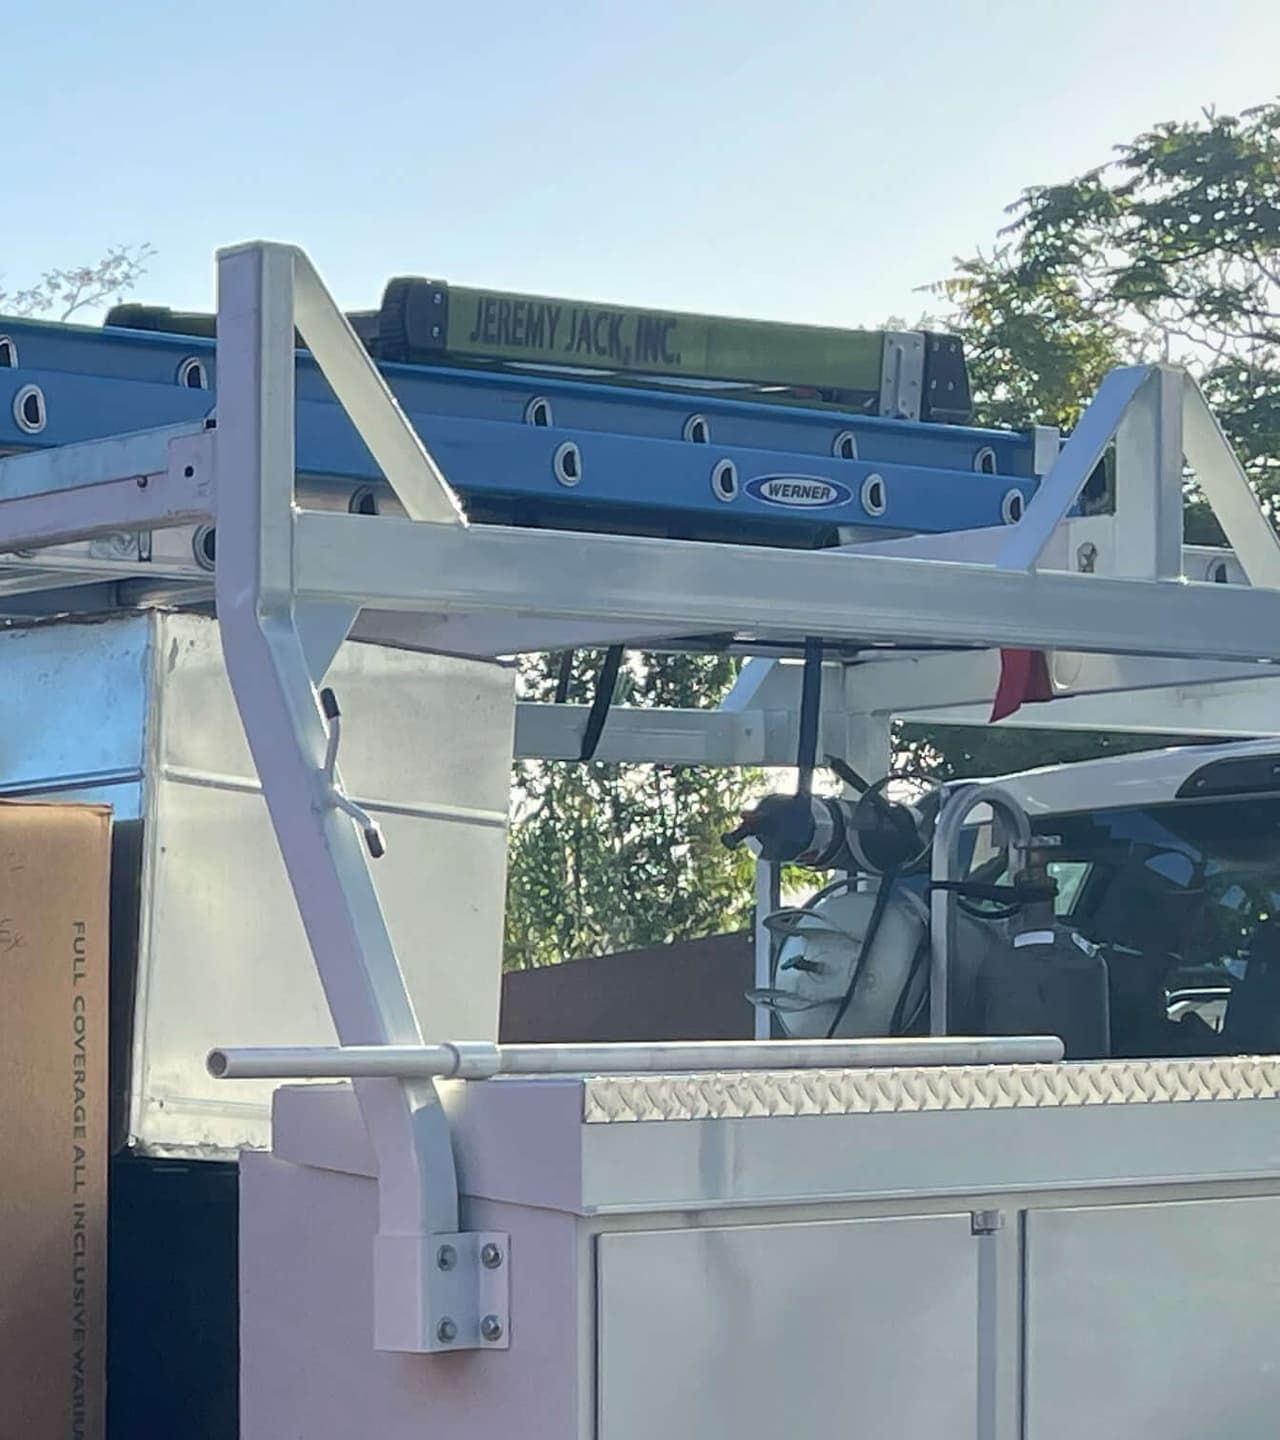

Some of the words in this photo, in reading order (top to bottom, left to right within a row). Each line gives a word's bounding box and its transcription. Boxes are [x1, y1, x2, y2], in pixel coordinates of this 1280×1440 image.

[470, 297, 561, 349] JEREMY
[565, 310, 631, 366] JACK,
[631, 316, 682, 366] INC.
[768, 482, 832, 502] WERNER
[72, 920, 86, 987] FULL
[72, 995, 87, 1140] COVERAGE
[71, 1145, 87, 1194] ALL
[71, 1203, 86, 1342] INCLUSIVE
